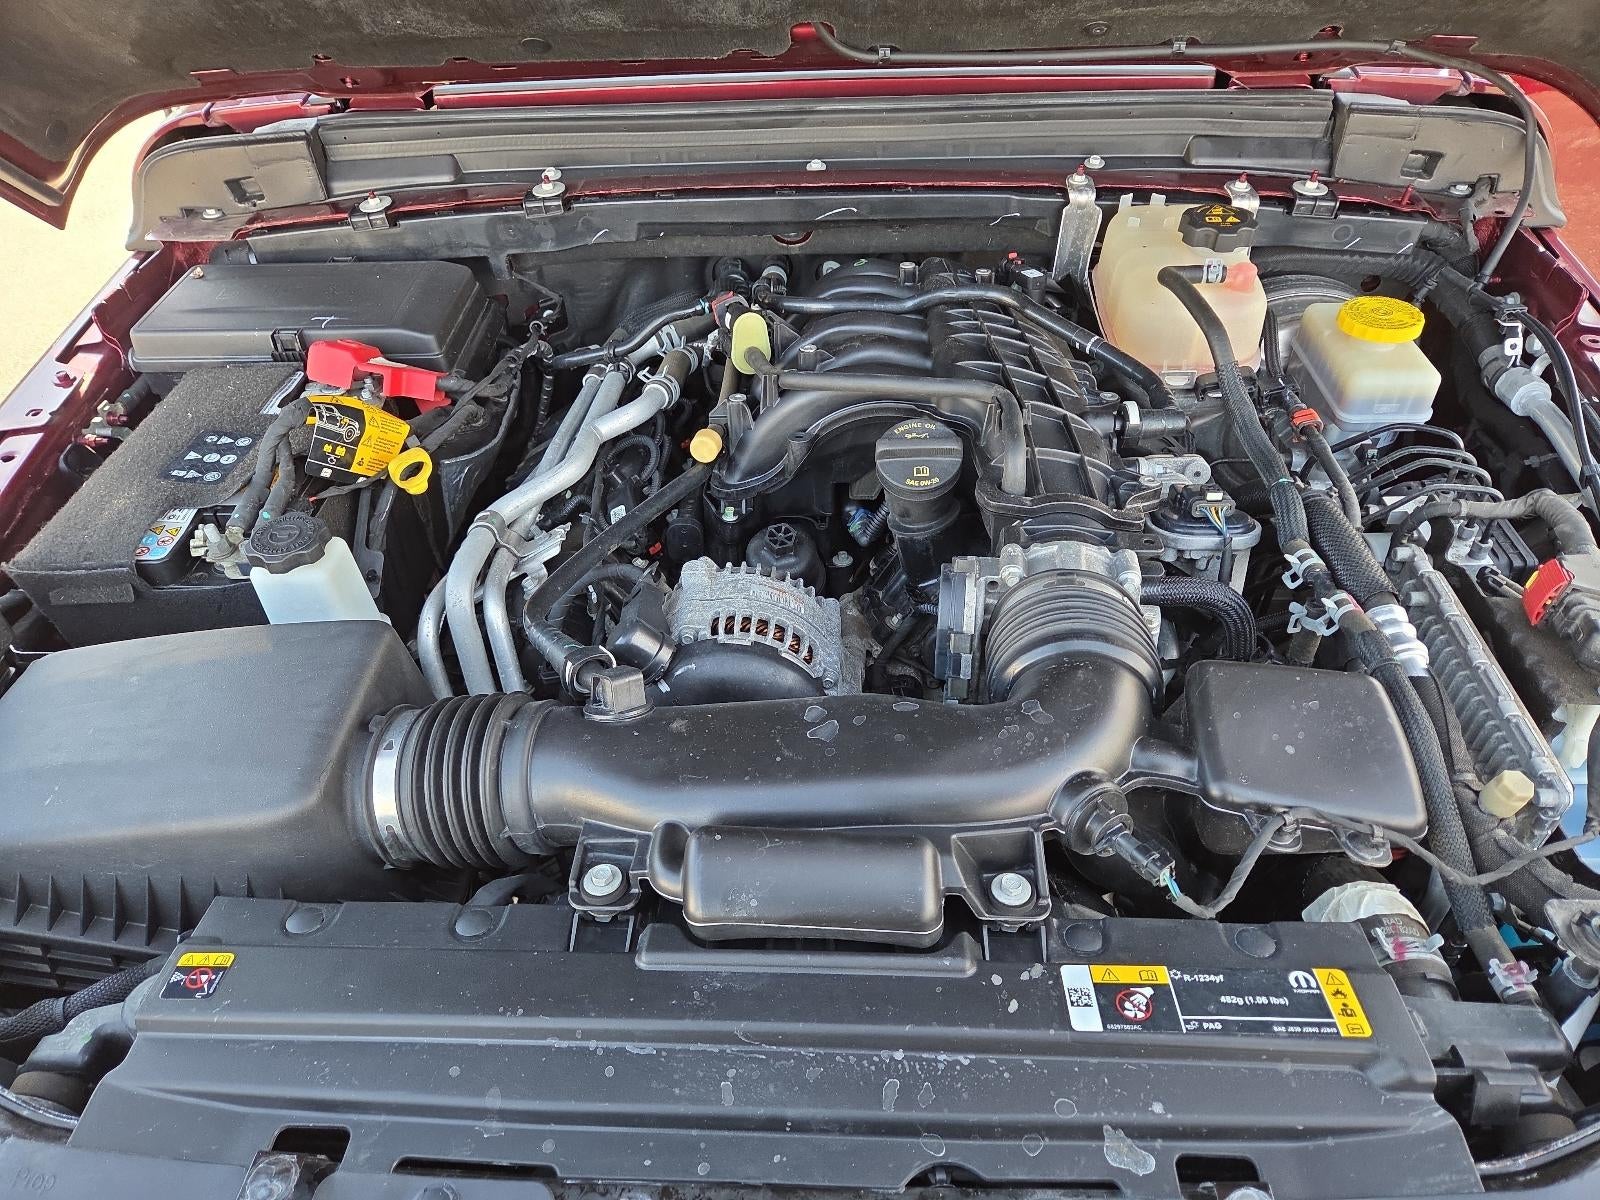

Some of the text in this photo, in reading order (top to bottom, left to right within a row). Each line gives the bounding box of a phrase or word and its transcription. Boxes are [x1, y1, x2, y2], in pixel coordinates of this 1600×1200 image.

[894, 422, 922, 434] ENGINE
[905, 477, 940, 487] SAE 0W-20
